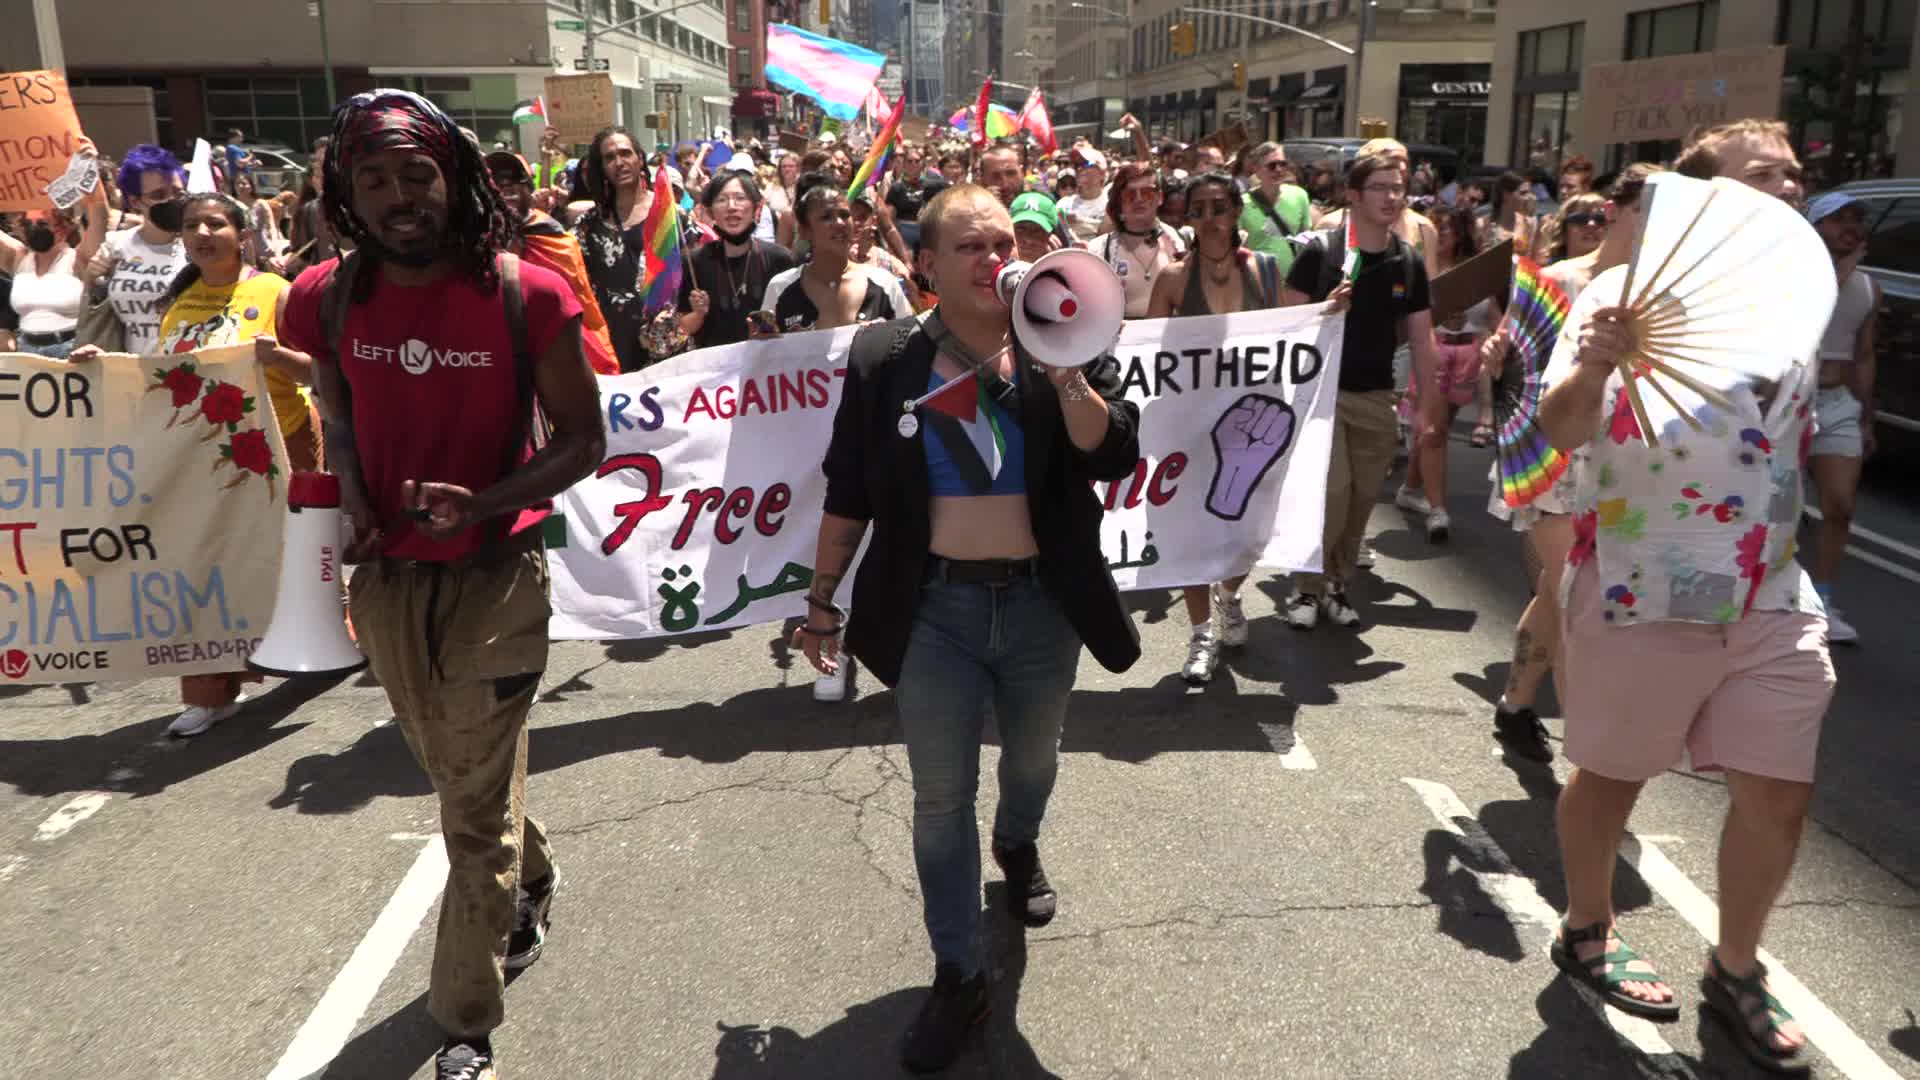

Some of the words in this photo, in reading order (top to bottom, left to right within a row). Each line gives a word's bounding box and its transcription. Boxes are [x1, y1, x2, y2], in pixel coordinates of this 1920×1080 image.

[114, 300, 161, 314] LIV
[353, 338, 395, 363] LEFT
[433, 348, 494, 367] VOICE
[0, 372, 94, 418] FOR
[606, 386, 664, 432] RS
[596, 452, 791, 556] Free
[60, 524, 157, 567] FOR
[33, 651, 110, 672] VOICE
